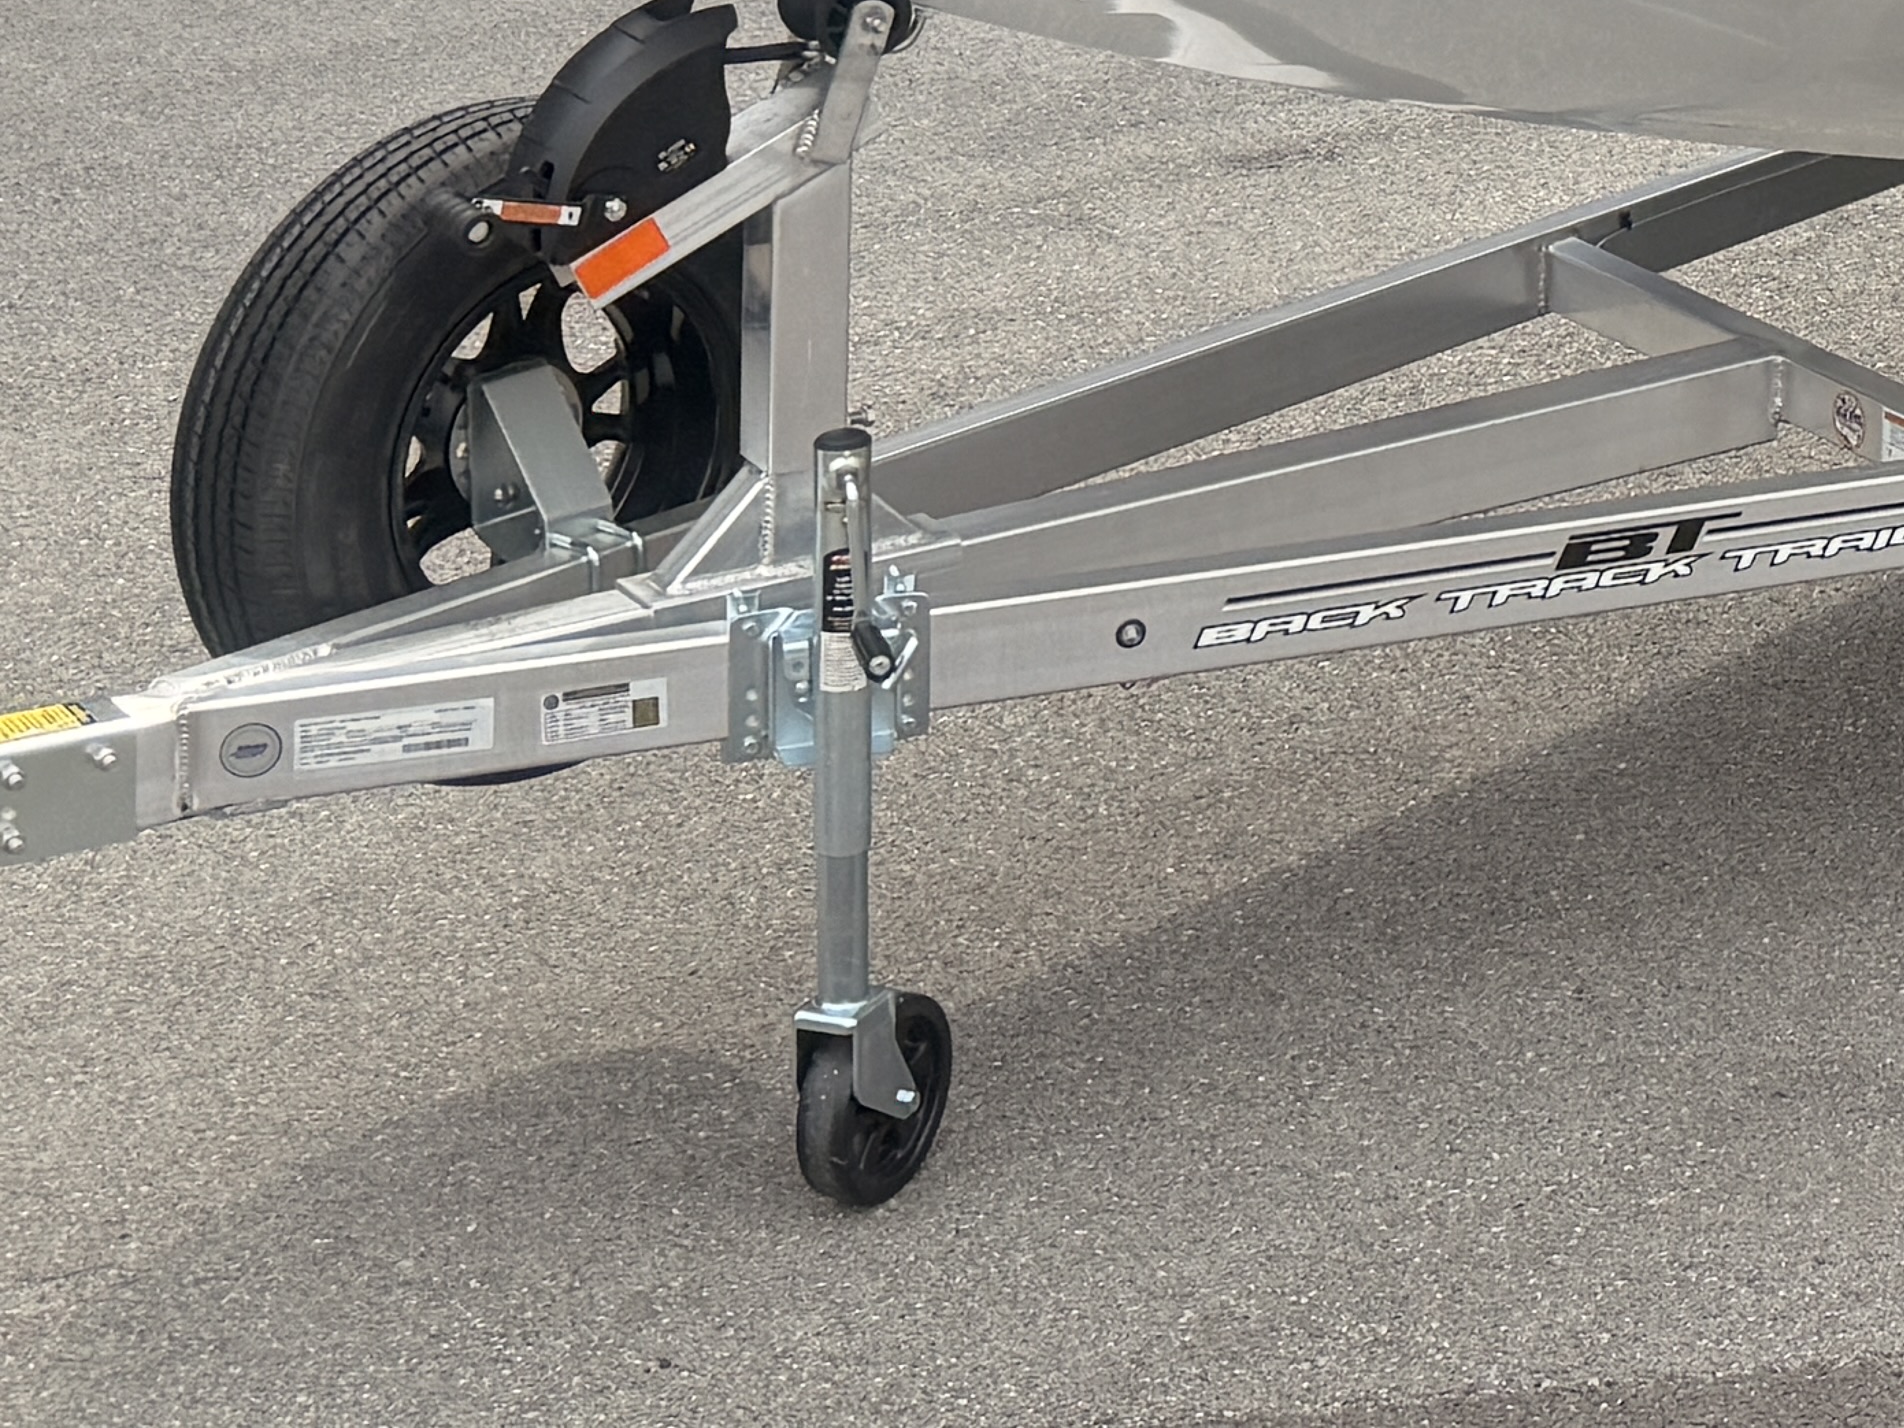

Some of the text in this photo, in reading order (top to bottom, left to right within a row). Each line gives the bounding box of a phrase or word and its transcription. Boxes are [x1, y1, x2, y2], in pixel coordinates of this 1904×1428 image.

[1554, 511, 1742, 573] BT
[1193, 592, 1420, 650] BACK
[1437, 552, 1702, 615] TRACK
